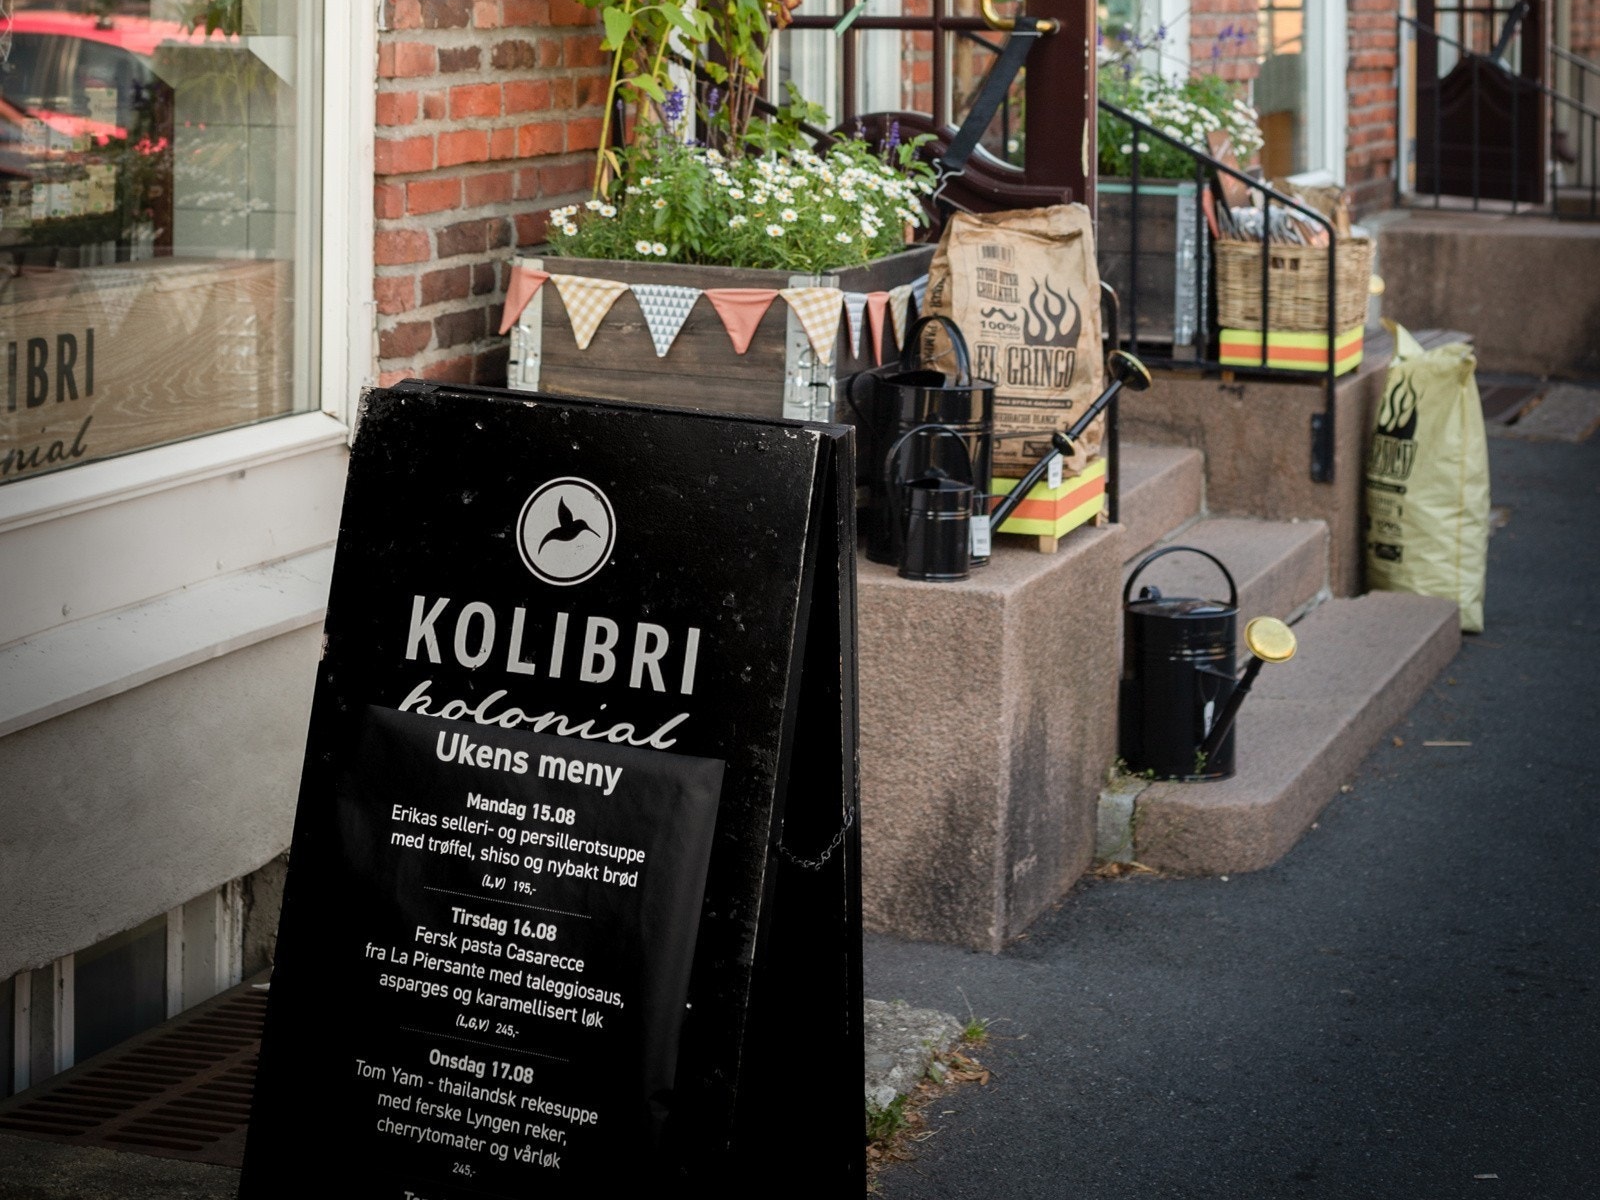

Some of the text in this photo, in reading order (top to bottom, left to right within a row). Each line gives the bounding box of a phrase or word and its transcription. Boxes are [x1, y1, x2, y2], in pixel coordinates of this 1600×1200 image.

[980, 320, 1020, 332] 100%
[7, 328, 94, 413] IBRI
[976, 345, 1075, 388] EL GRINGO
[0, 415, 93, 475] nial
[405, 594, 700, 695] KOLIBRI
[398, 679, 690, 750] kolonial
[435, 730, 624, 796] Ukens meny
[391, 803, 646, 865] Erikas selleri- og persillerotsuppe
[466, 791, 576, 826] Mandag 15.08
[390, 832, 639, 888] med trøffel, shiso og nybakt brød
[481, 873, 537, 896] (L,V) 195,-
[414, 925, 585, 973] Fersk pasta Casarecce
[451, 906, 558, 942] Tirsdag 16.08
[365, 941, 625, 1009] fra La Piersante med taleggiosaus,
[379, 973, 604, 1029] asparges og karamellisert løk
[455, 1013, 520, 1039] (L,G,V) 245,-
[355, 1059, 386, 1081] Tom
[391, 1066, 424, 1088] Yam
[438, 1076, 517, 1108] thailandsk
[520, 1095, 599, 1126] rekesuppe
[429, 1048, 534, 1085] Onsdag 17.08
[376, 1116, 561, 1170] cherrytomater og vårløk
[377, 1093, 567, 1147] med ferske Lyngen reker,
[452, 1162, 476, 1178] 245,-
